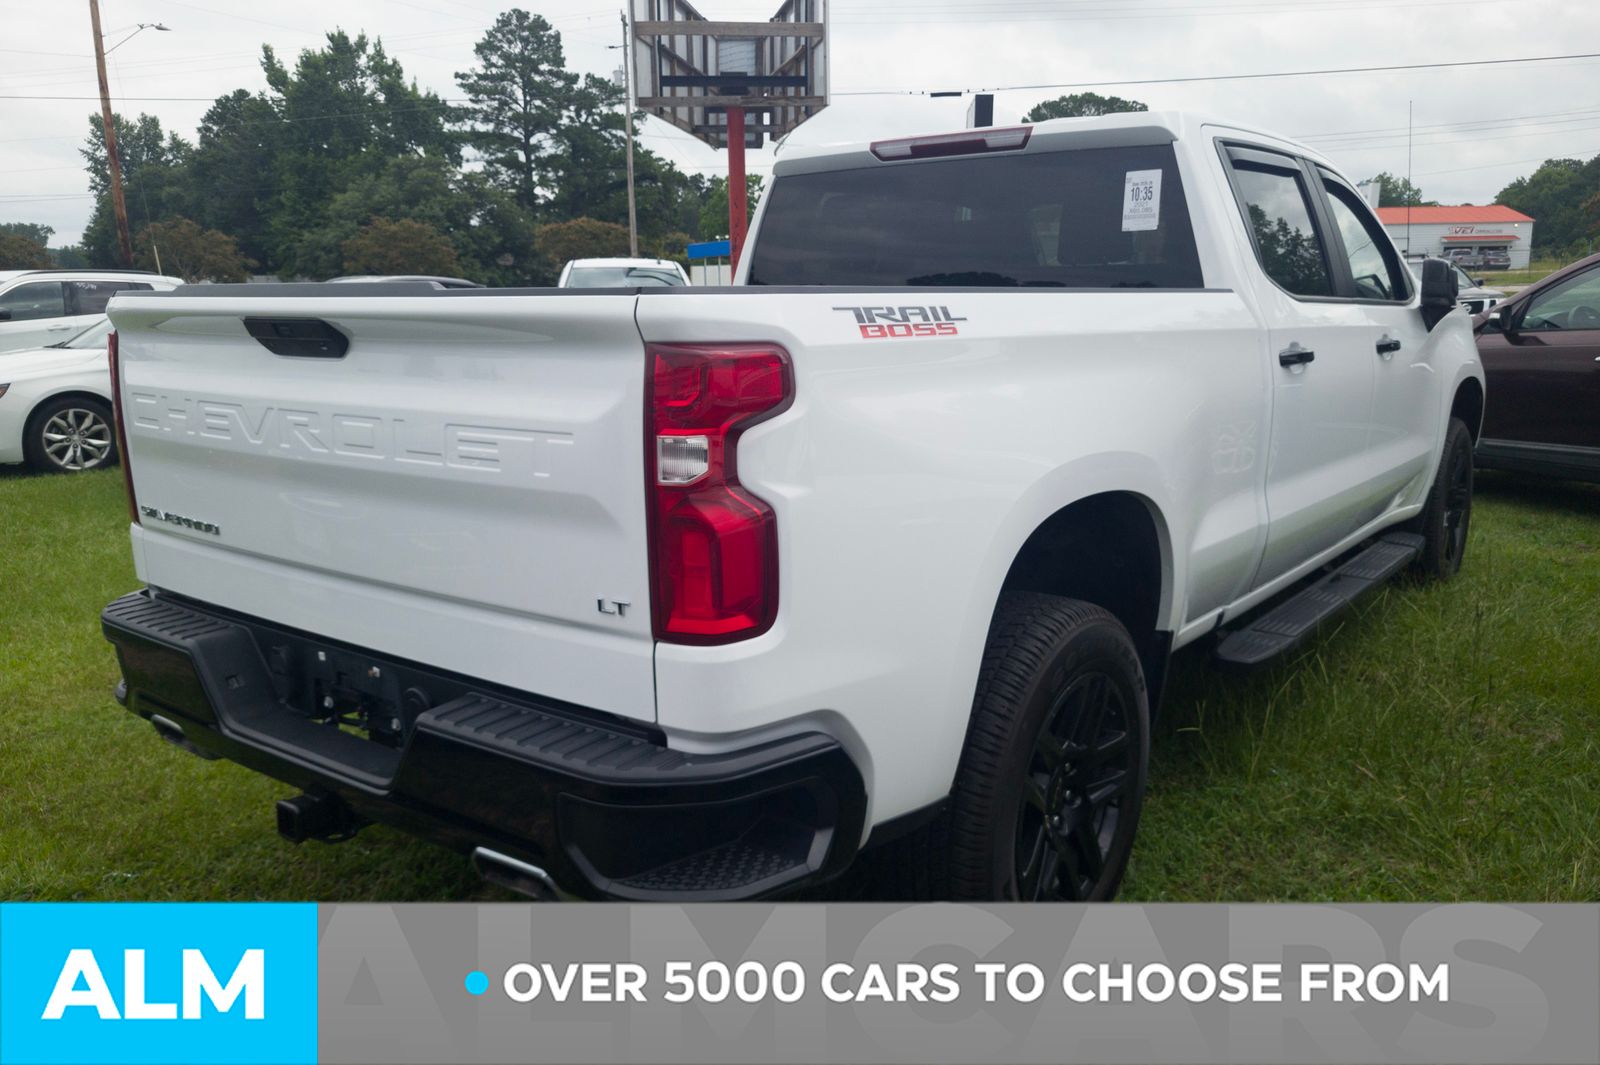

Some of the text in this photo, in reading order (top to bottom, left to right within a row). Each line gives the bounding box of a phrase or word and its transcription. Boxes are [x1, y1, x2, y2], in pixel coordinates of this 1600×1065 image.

[1131, 186, 1153, 202] 10:35
[832, 306, 967, 324] TRAIL
[859, 322, 958, 338] BOSS
[131, 392, 575, 478] CHEVROLET
[597, 598, 631, 617] LT
